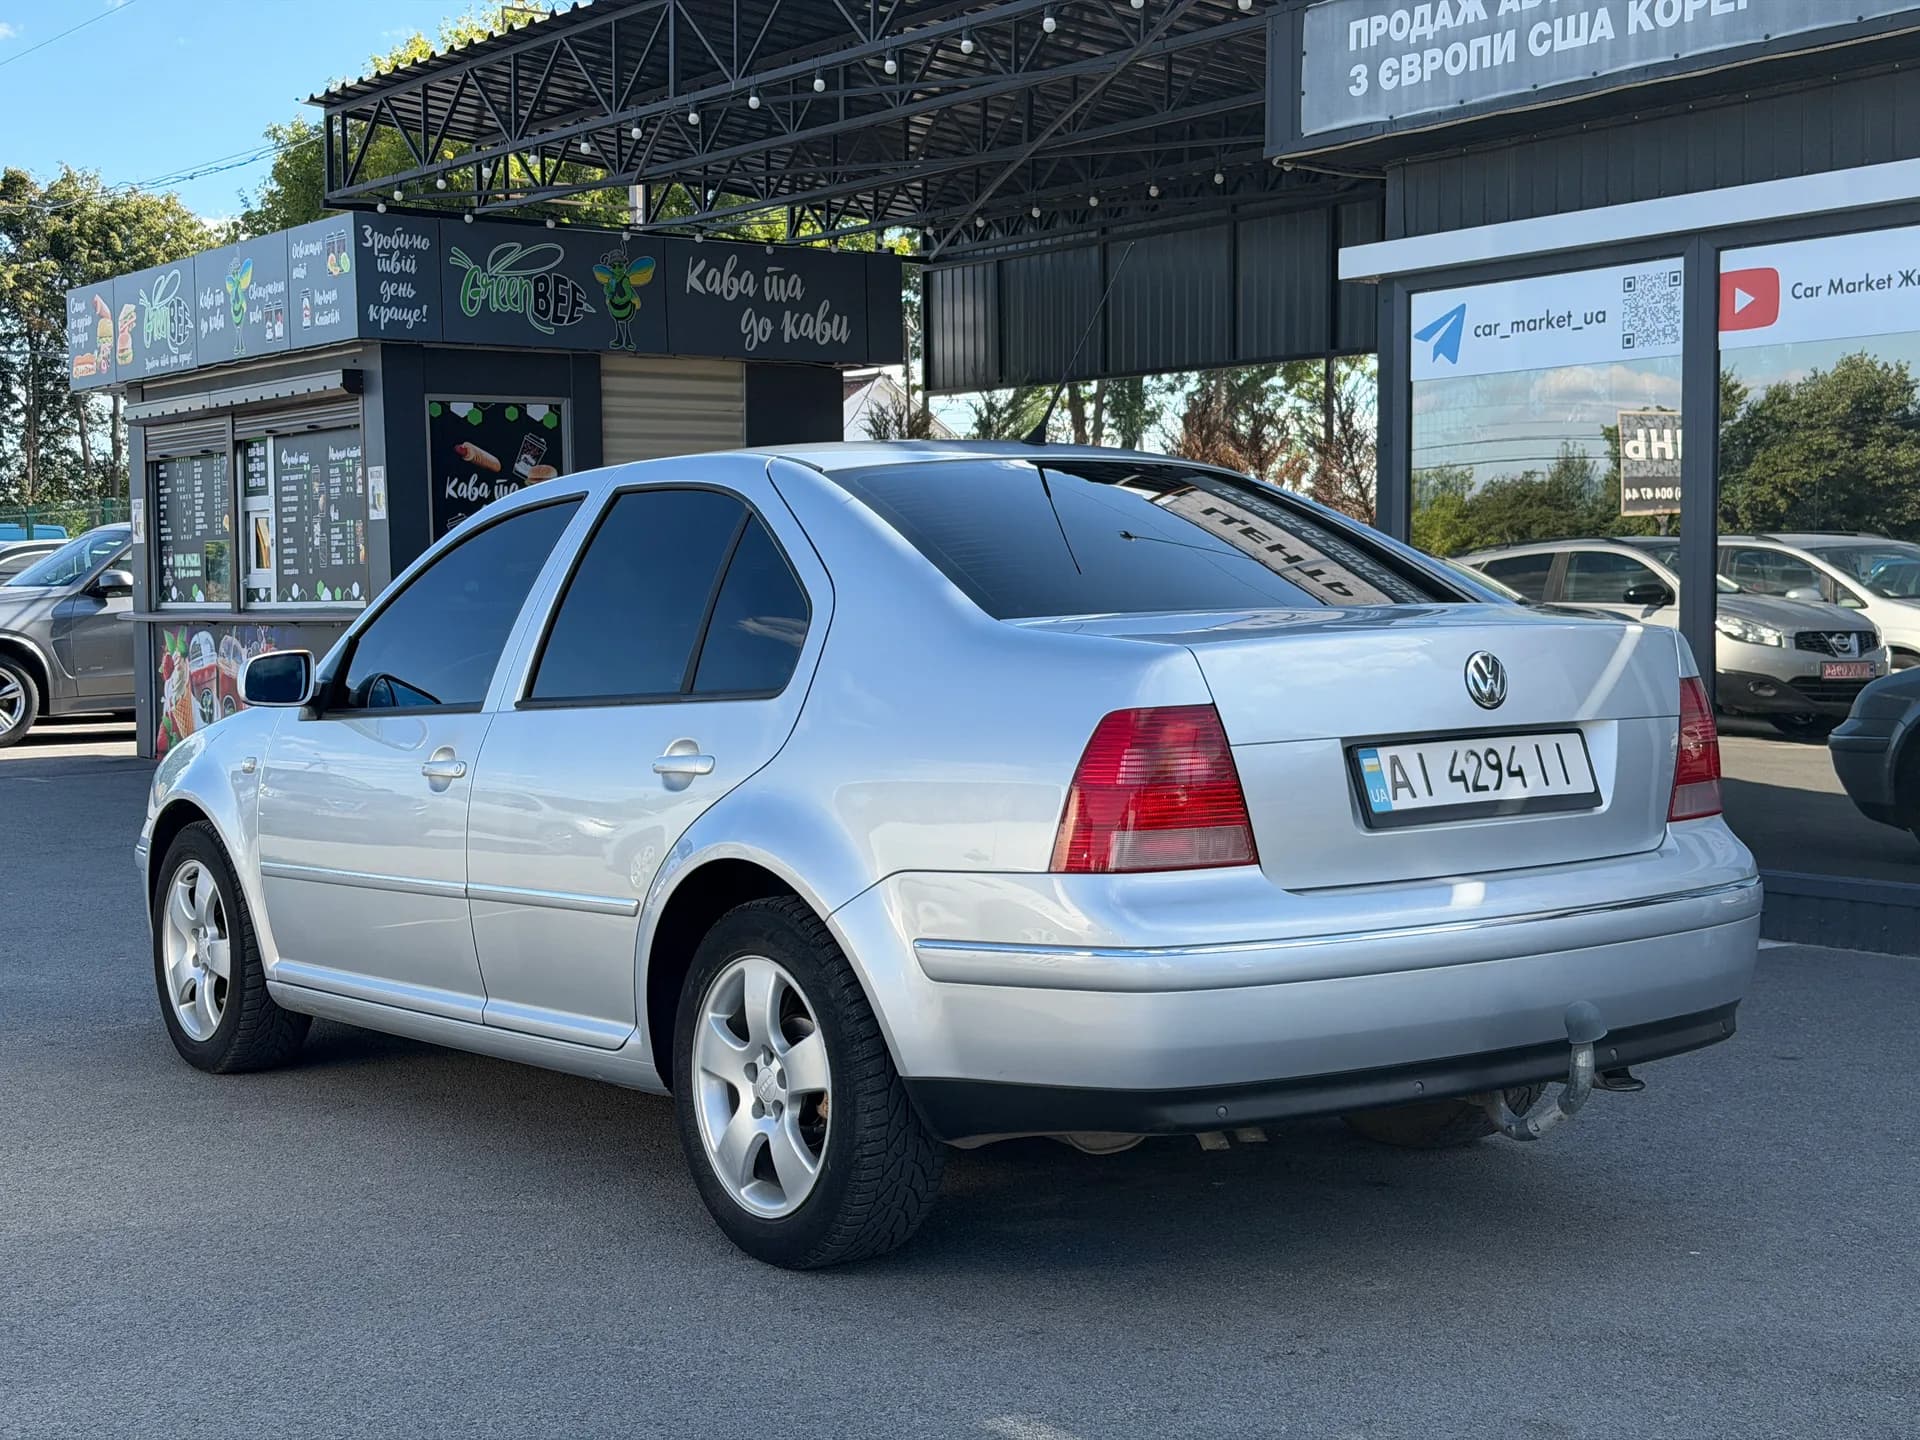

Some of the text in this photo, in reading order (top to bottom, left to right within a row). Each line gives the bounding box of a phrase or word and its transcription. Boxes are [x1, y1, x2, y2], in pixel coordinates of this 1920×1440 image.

[1349, 0, 1489, 51] ПРОДАЖ
[1349, 64, 1369, 97] З
[1378, 29, 1516, 90] ЄВРОПИ
[1528, 8, 1615, 57] США
[362, 225, 430, 256] Зробимо
[377, 250, 417, 274] твій
[380, 280, 416, 303] день
[686, 254, 805, 303] Кава та
[1791, 282, 1822, 300] Car
[1828, 273, 1893, 296] Market
[368, 304, 428, 330] краще!
[741, 300, 851, 351] до кави
[1474, 309, 1606, 339] car_market_ua
[445, 473, 491, 501] Кава
[1388, 752, 1433, 801] AI
[1449, 743, 1527, 793] 4294
[1370, 788, 1388, 803] UA
